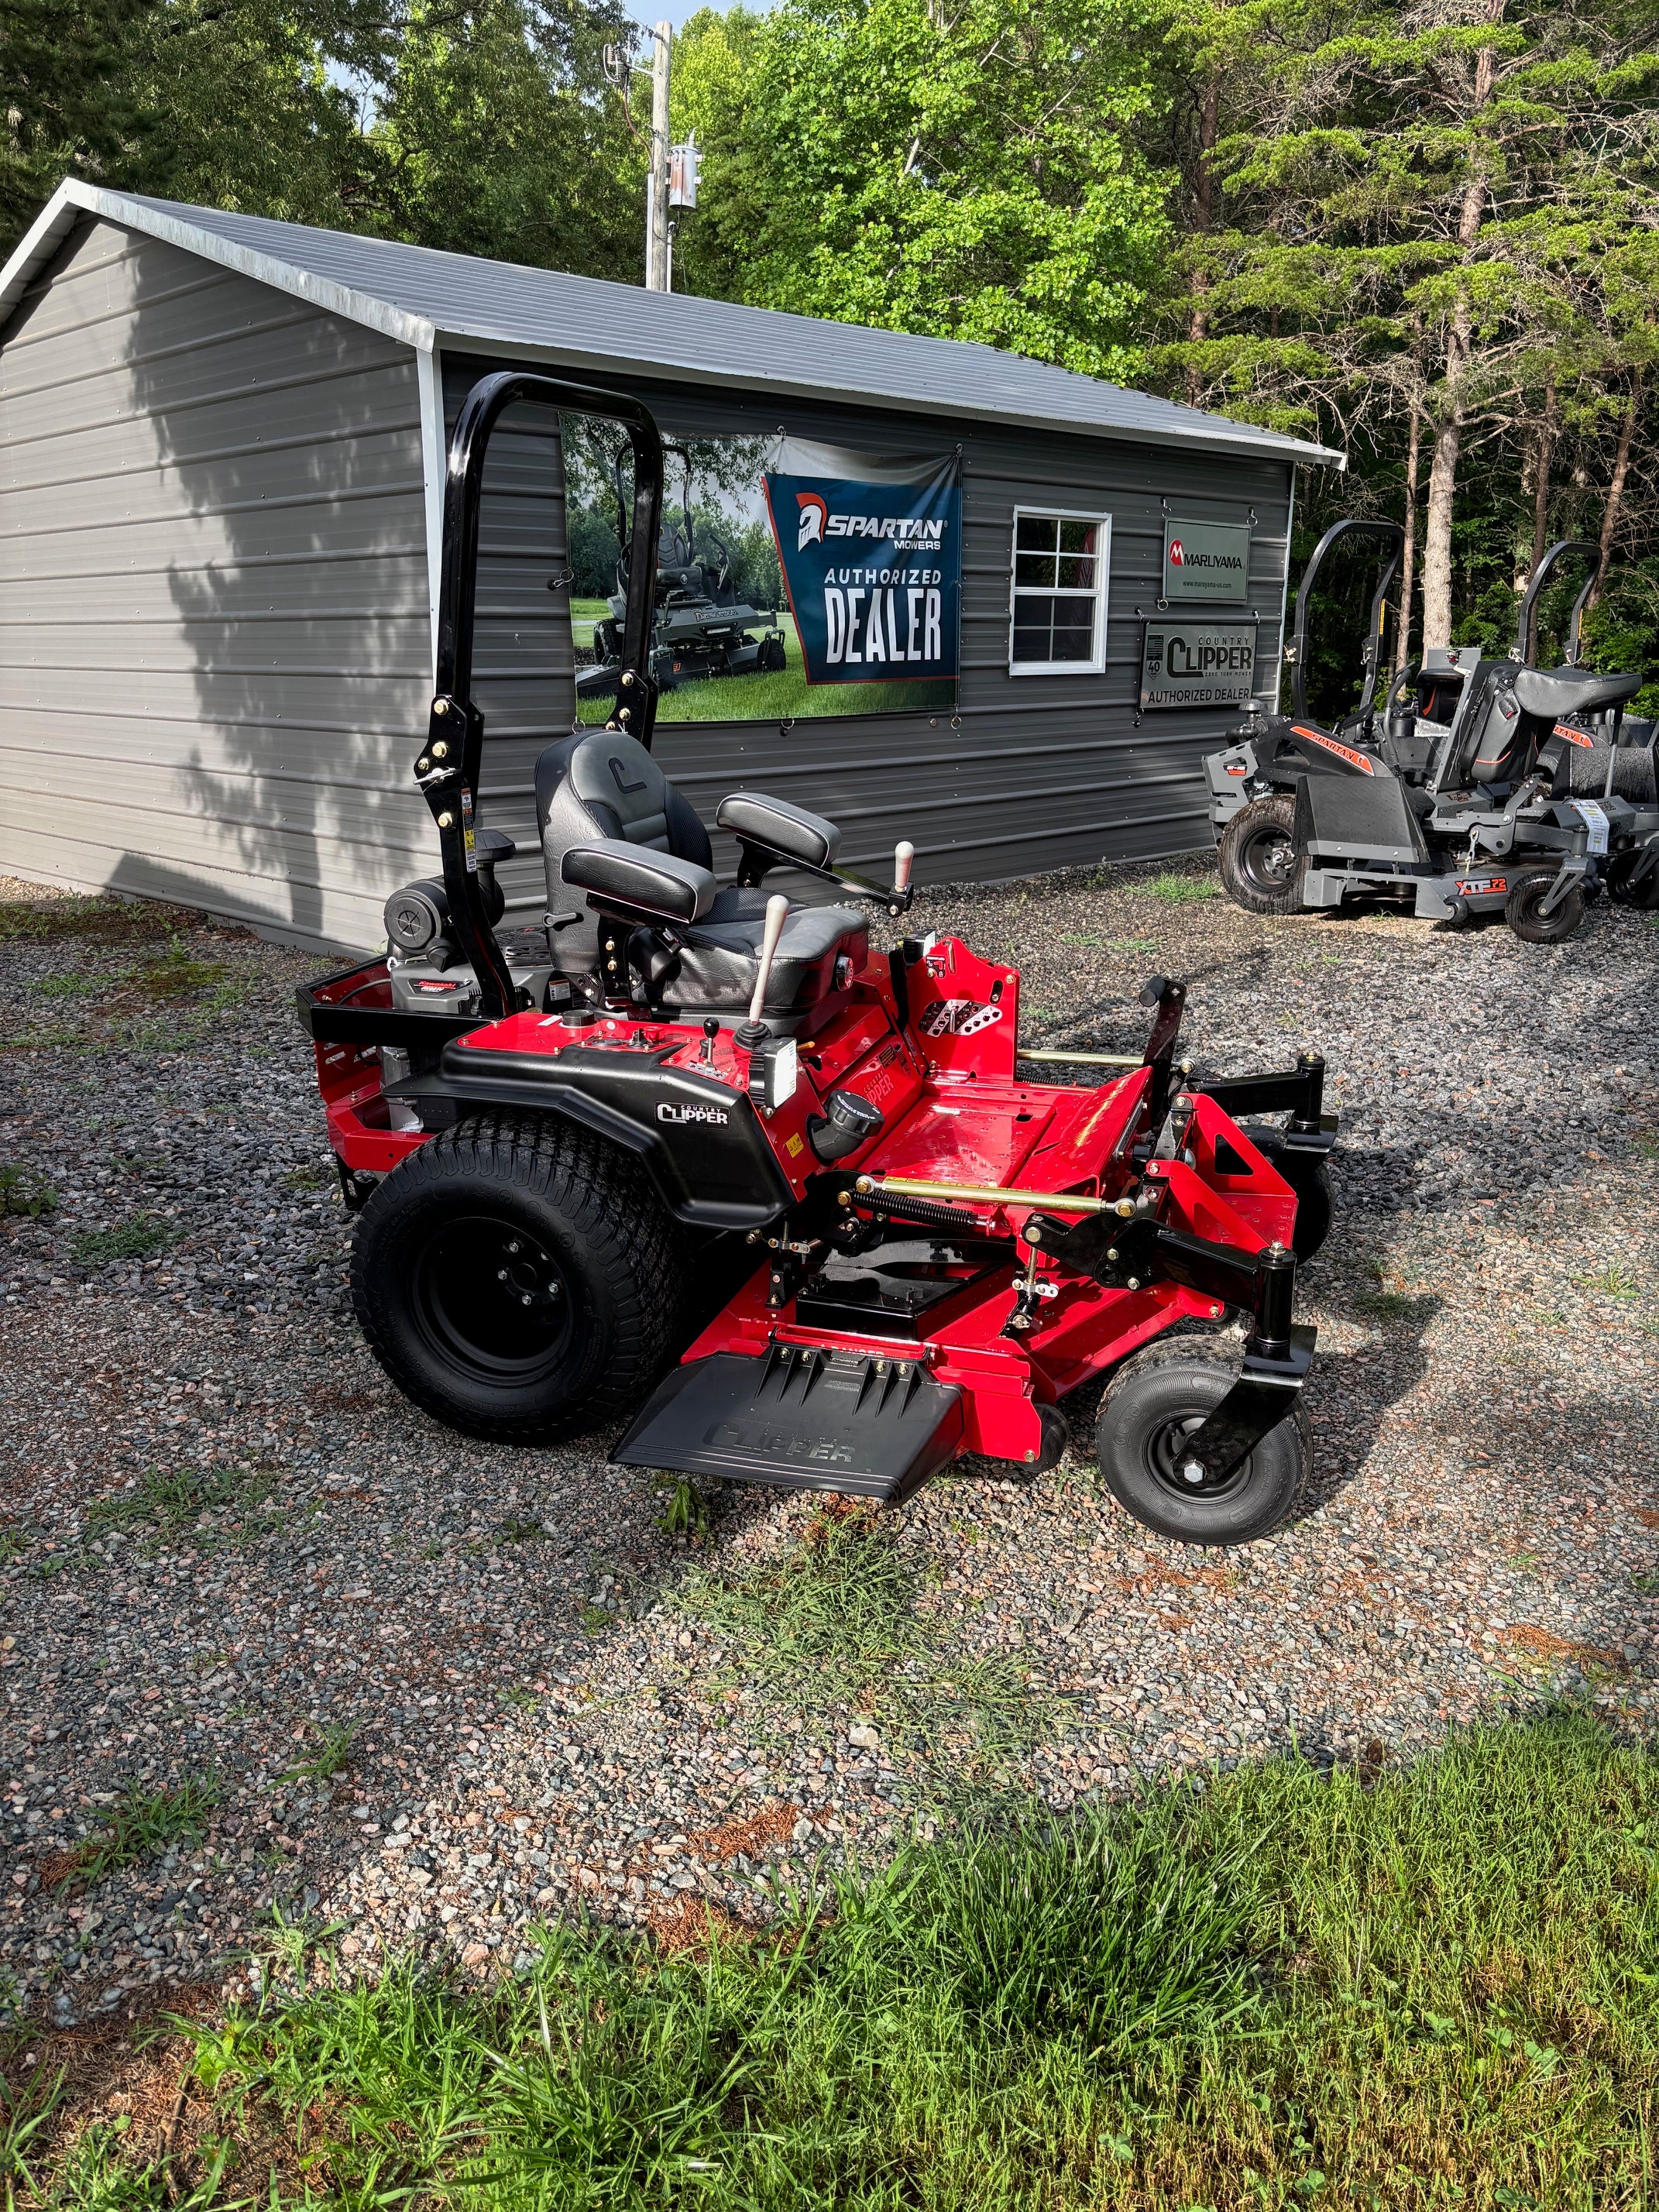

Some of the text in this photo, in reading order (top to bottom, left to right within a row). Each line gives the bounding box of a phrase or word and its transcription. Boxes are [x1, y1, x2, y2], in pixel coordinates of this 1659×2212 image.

[825, 514, 943, 540] SPARTAN
[894, 540, 941, 551] MOWERS
[1183, 553, 1242, 570] MARUYAMA
[824, 568, 942, 585] AUTHORIZED
[1183, 581, 1232, 589] www.maruyama-us.com
[824, 587, 942, 664] DEALER
[1198, 636, 1249, 645] COUNTRY
[1166, 636, 1252, 678] CLIPPER
[1148, 661, 1160, 672] 40
[1148, 688, 1249, 703] AUTHORIZED DEALER
[1311, 734, 1355, 761] SPARTAN
[1455, 878, 1506, 896] XTF 72
[657, 1104, 728, 1125] CLIPPER
[681, 1104, 721, 1113] COUNTRY
[702, 1420, 856, 1463] CLIPPER
